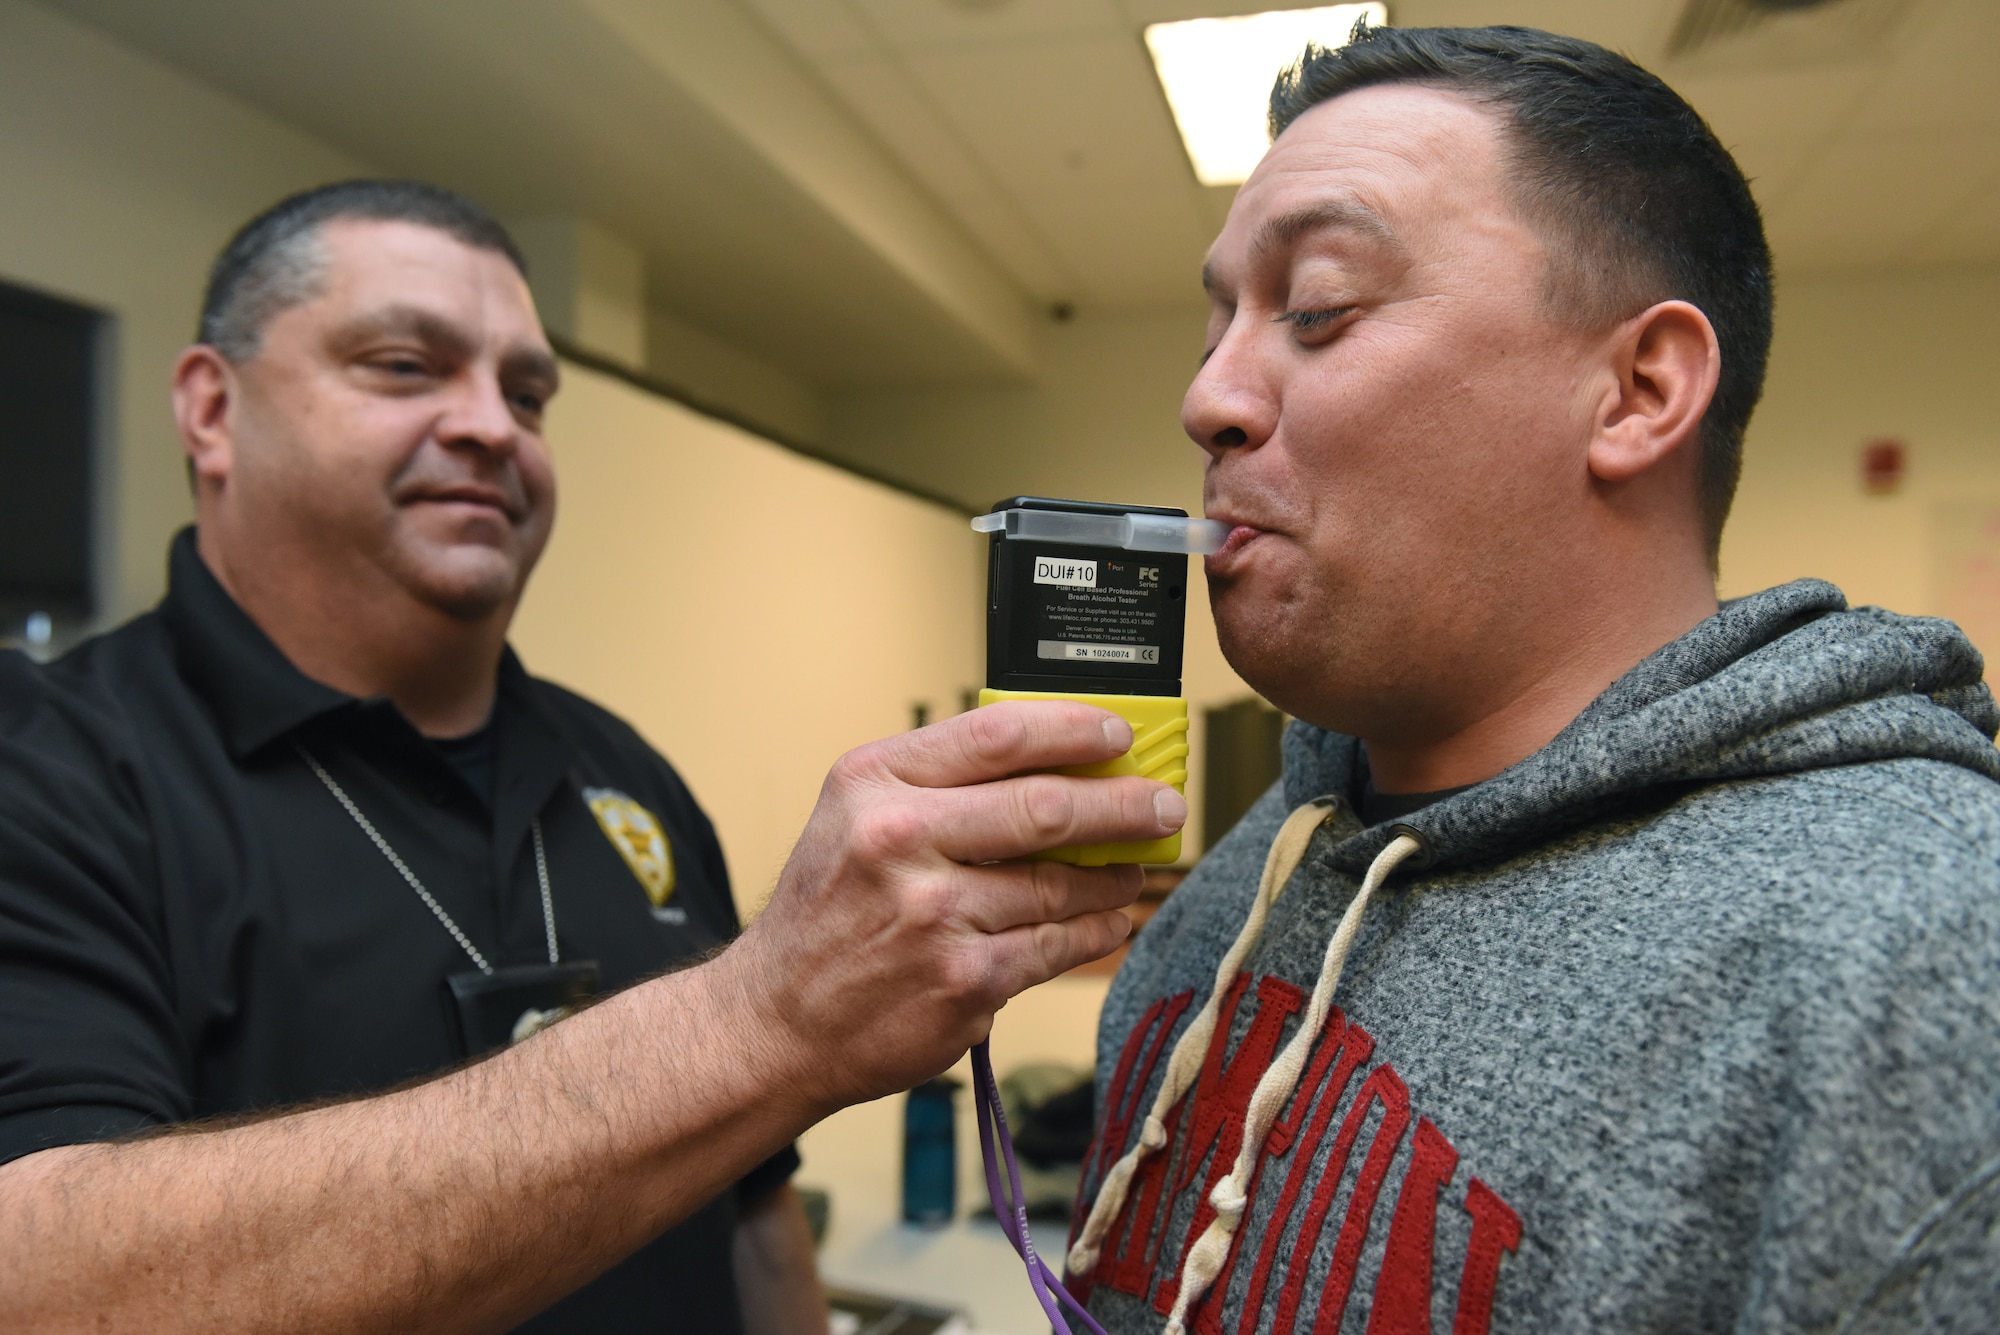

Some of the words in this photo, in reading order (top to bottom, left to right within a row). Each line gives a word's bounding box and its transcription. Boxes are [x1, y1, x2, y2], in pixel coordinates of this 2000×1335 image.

[1038, 563, 1094, 582] DUI#10
[1138, 567, 1160, 581] FC
[1087, 586, 1107, 594] Based
[1108, 587, 1149, 596] Professional
[1068, 593, 1090, 601] Breath
[1092, 595, 1116, 603] Alcohol
[1085, 607, 1108, 615] Supplies
[1048, 614, 1092, 622] www.lifeloc.com
[1076, 648, 1088, 656] SN
[1092, 649, 1130, 658] 10240074
